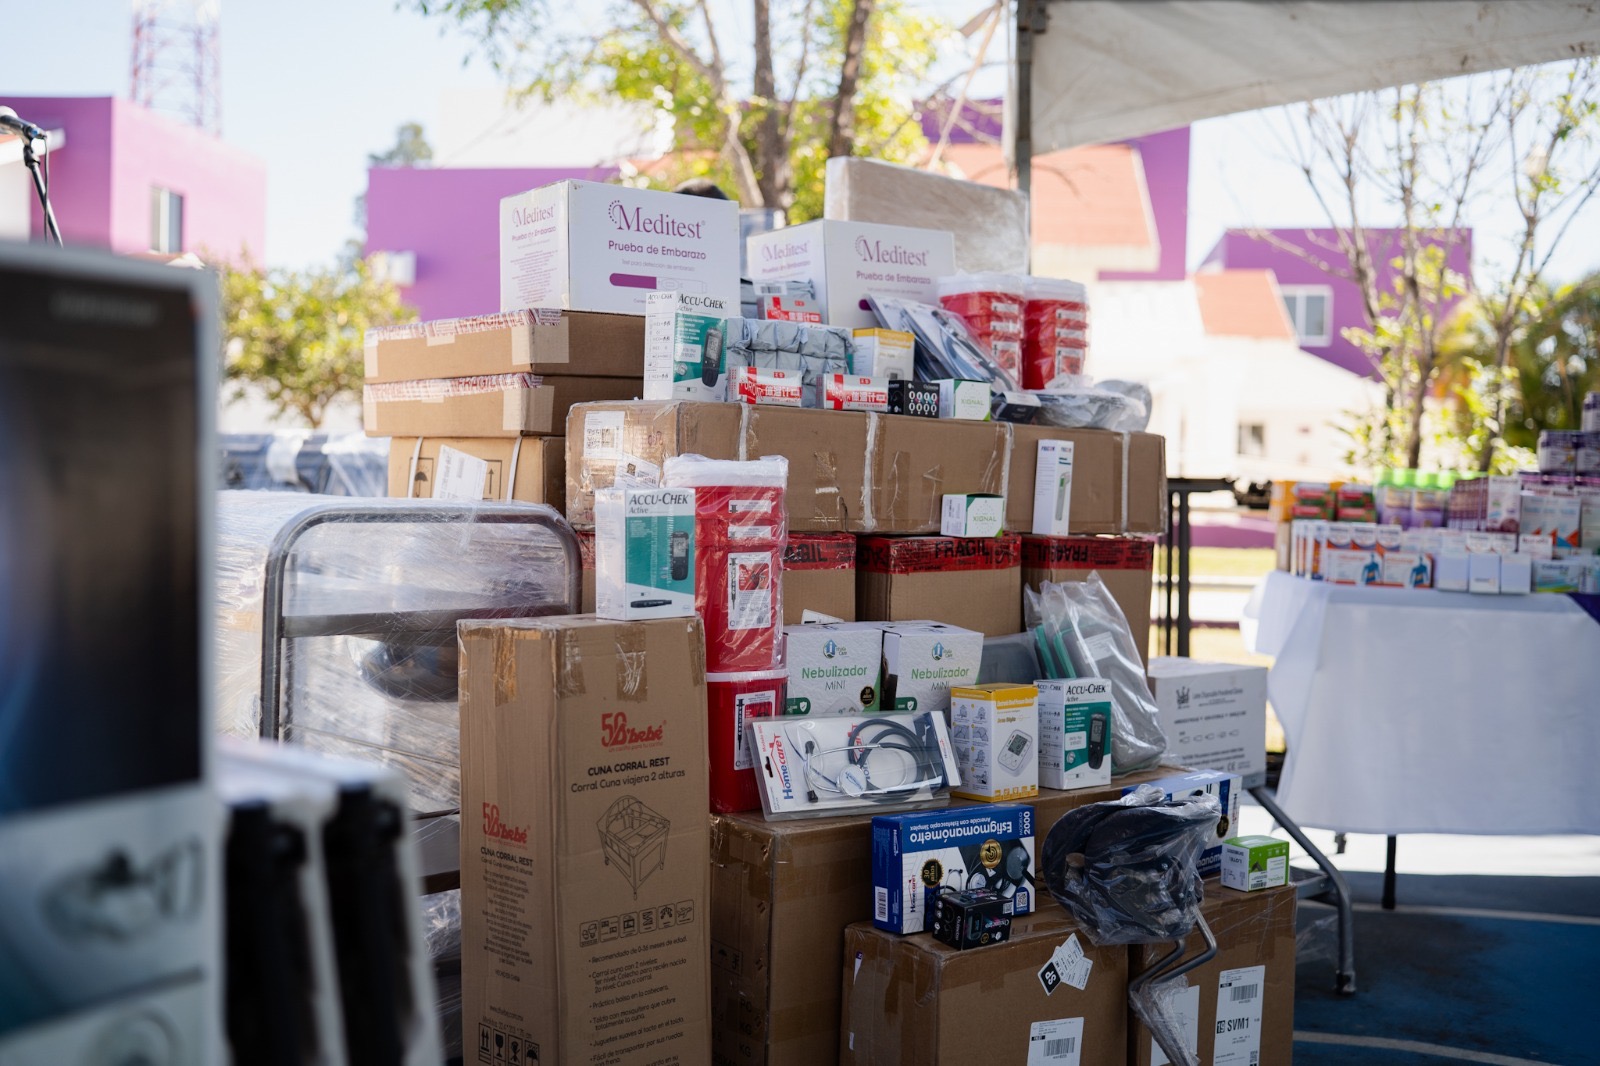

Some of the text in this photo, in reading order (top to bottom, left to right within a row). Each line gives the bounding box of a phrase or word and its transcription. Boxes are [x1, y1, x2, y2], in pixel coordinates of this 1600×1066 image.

[513, 205, 554, 228] Meditest
[612, 203, 702, 239] Meditest
[608, 240, 706, 260] Prueba de Embarazo
[762, 242, 808, 262] Meditest
[858, 239, 928, 267] Meditest
[856, 270, 931, 285] Prueba de Embarazo
[629, 492, 689, 506] ACCU-CHEK
[629, 506, 649, 514] Active
[935, 540, 990, 559] FRAGIL
[802, 665, 867, 679] Nebulizador
[912, 667, 969, 679] Nebulizador
[825, 680, 846, 691] MINI
[931, 681, 950, 691] MINI
[1066, 683, 1106, 695] ACCU-CHEK
[588, 757, 670, 776] CUNA CORRAL REST
[571, 769, 686, 793] Corral Cuna viajera 2 alturas
[1023, 811, 1031, 836] 2000
[909, 821, 1013, 845] Esfigmomanómetro
[480, 846, 534, 868] CUNA CORRAL REST
[923, 869, 930, 879] 30
[1045, 970, 1057, 985] SP
[1227, 1017, 1249, 1032] SVM1
